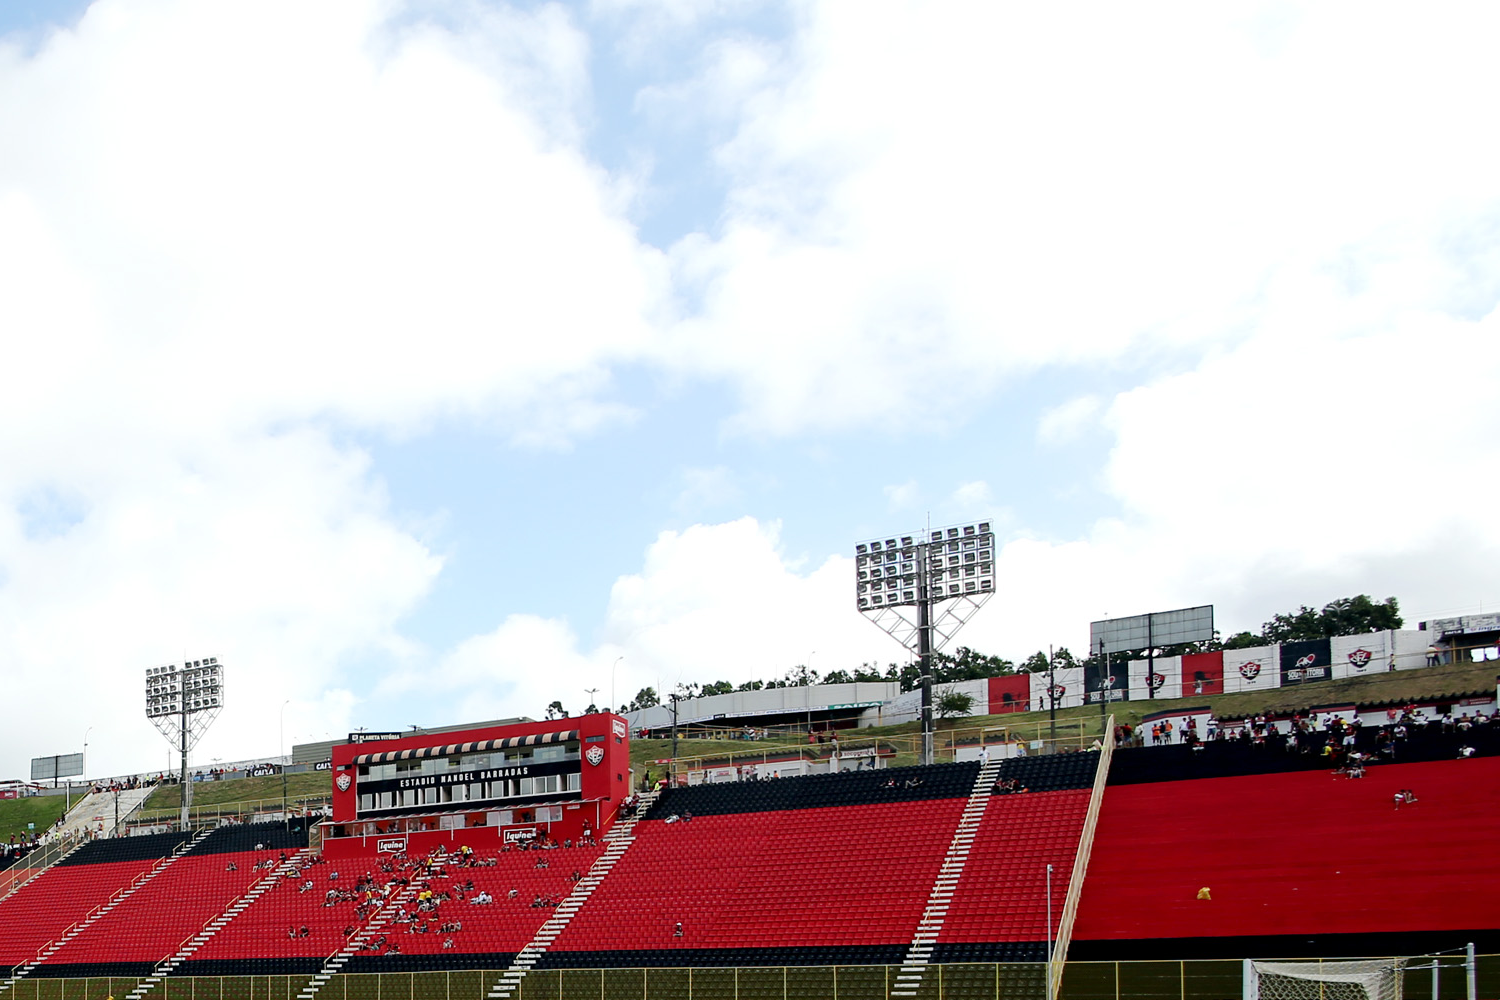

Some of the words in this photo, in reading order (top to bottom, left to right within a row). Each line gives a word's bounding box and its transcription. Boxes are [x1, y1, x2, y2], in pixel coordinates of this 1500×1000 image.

[441, 772, 475, 783] MANOEL
[480, 766, 529, 779] BARRADAS
[506, 831, 533, 841] Iquine
[380, 841, 404, 850] Iquine
